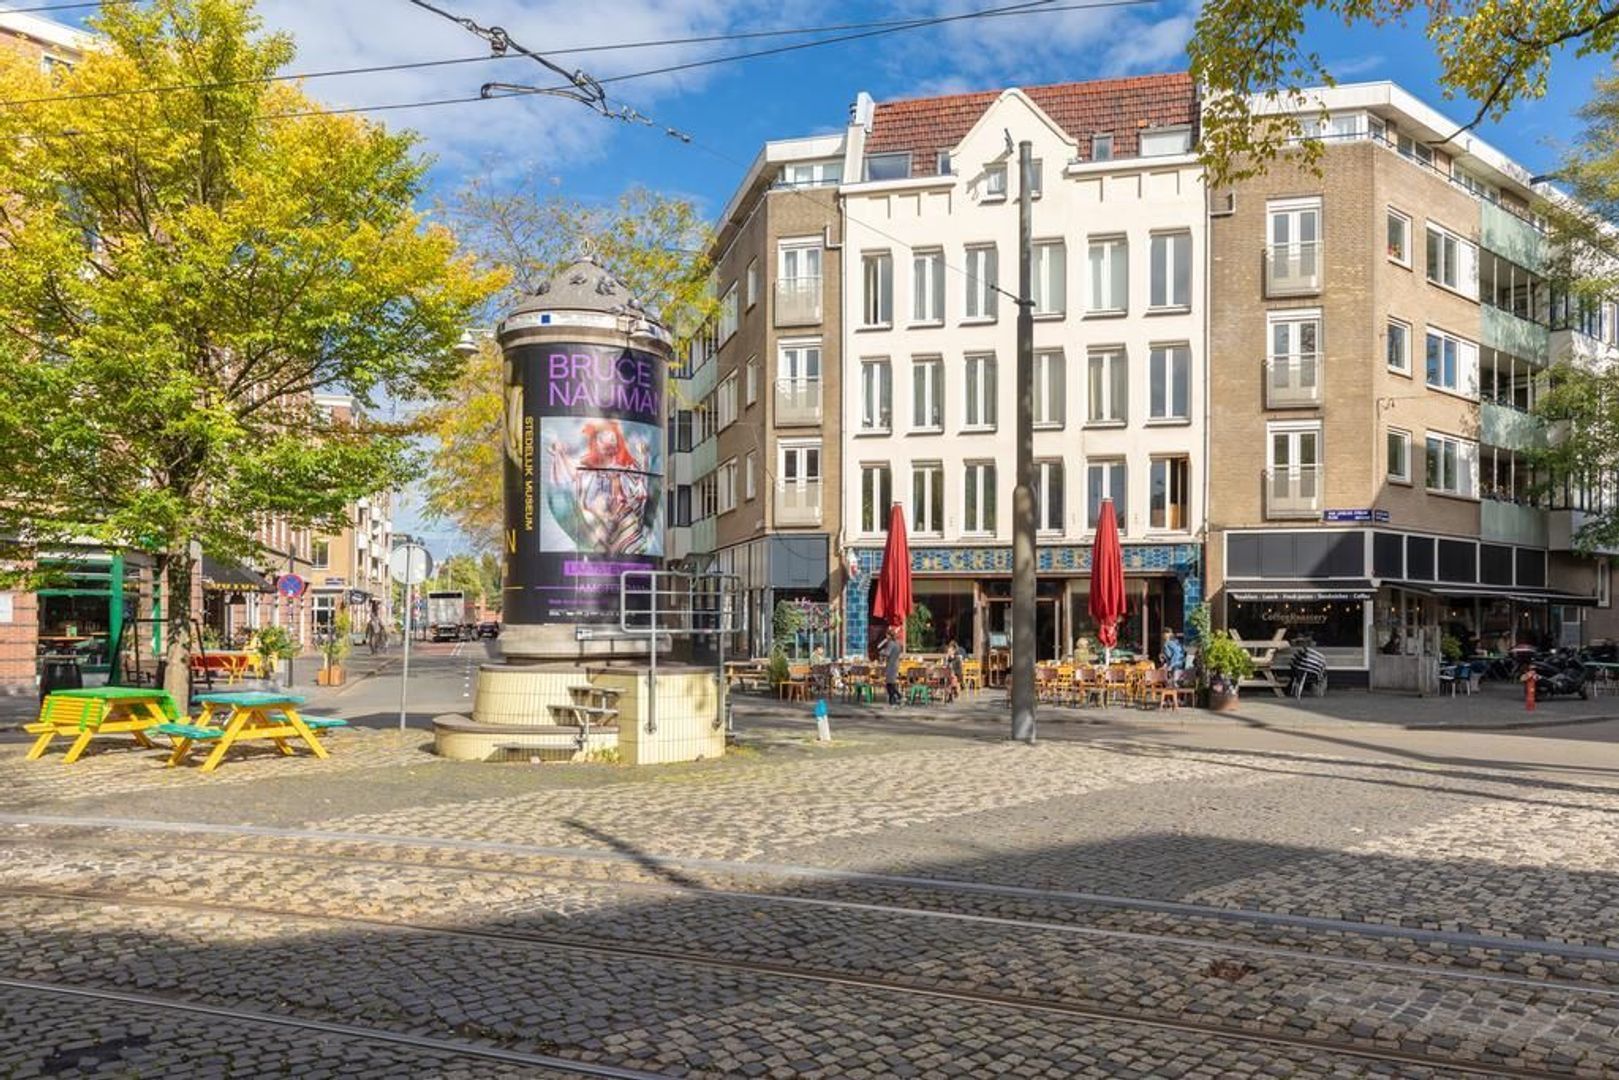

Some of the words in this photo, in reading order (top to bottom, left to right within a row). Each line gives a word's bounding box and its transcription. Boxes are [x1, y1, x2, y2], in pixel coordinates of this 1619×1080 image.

[549, 353, 651, 388] BRUCE
[524, 416, 534, 475] STEDELIJK
[524, 480, 534, 531] MUSEUM
